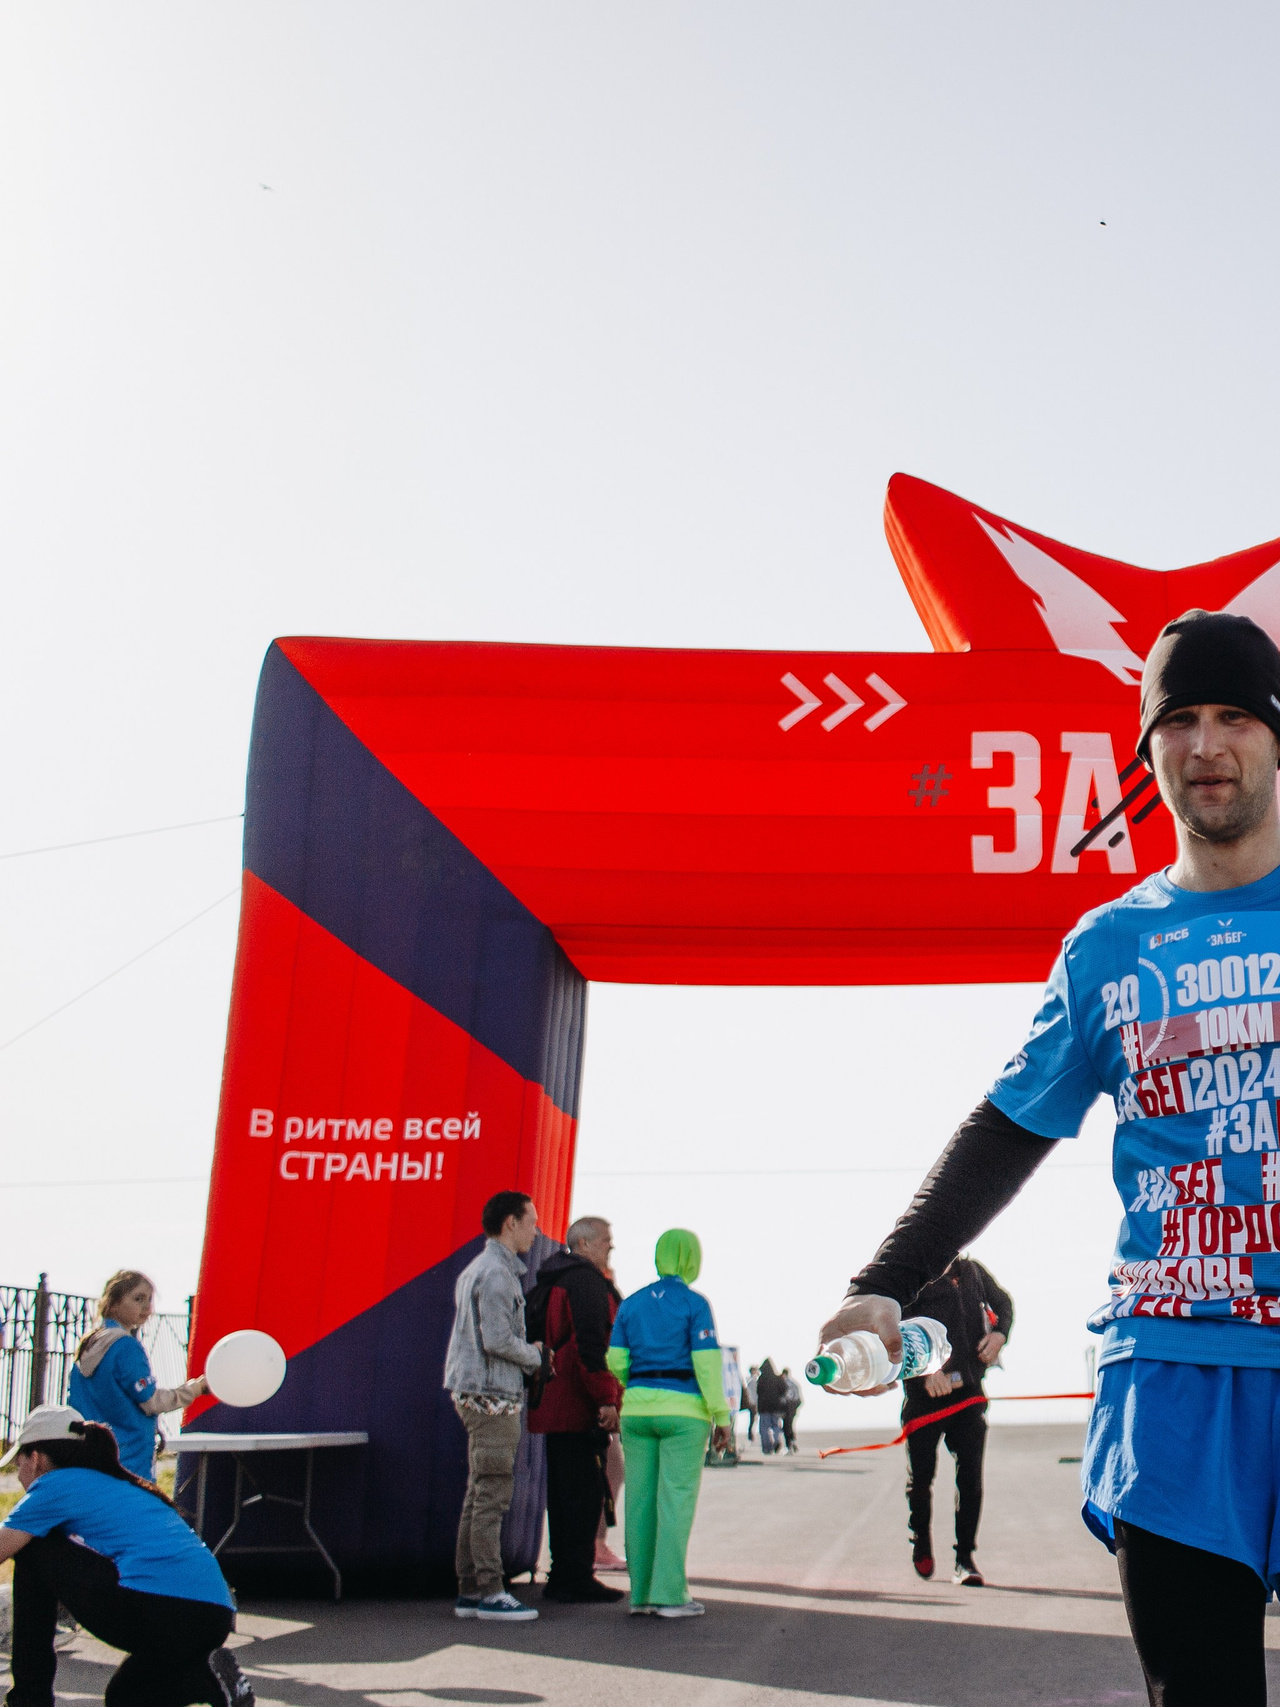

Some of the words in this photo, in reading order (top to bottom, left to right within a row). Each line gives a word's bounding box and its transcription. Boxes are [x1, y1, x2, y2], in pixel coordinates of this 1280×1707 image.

[1165, 927, 1190, 944] ПСБ
[1101, 974, 1140, 1030] 20
[1196, 1002, 1275, 1050] 10КМ
[249, 1108, 274, 1138] В
[284, 1116, 393, 1144] ритме
[404, 1111, 481, 1141] всей
[279, 1150, 445, 1182] СТРАНЫ!
